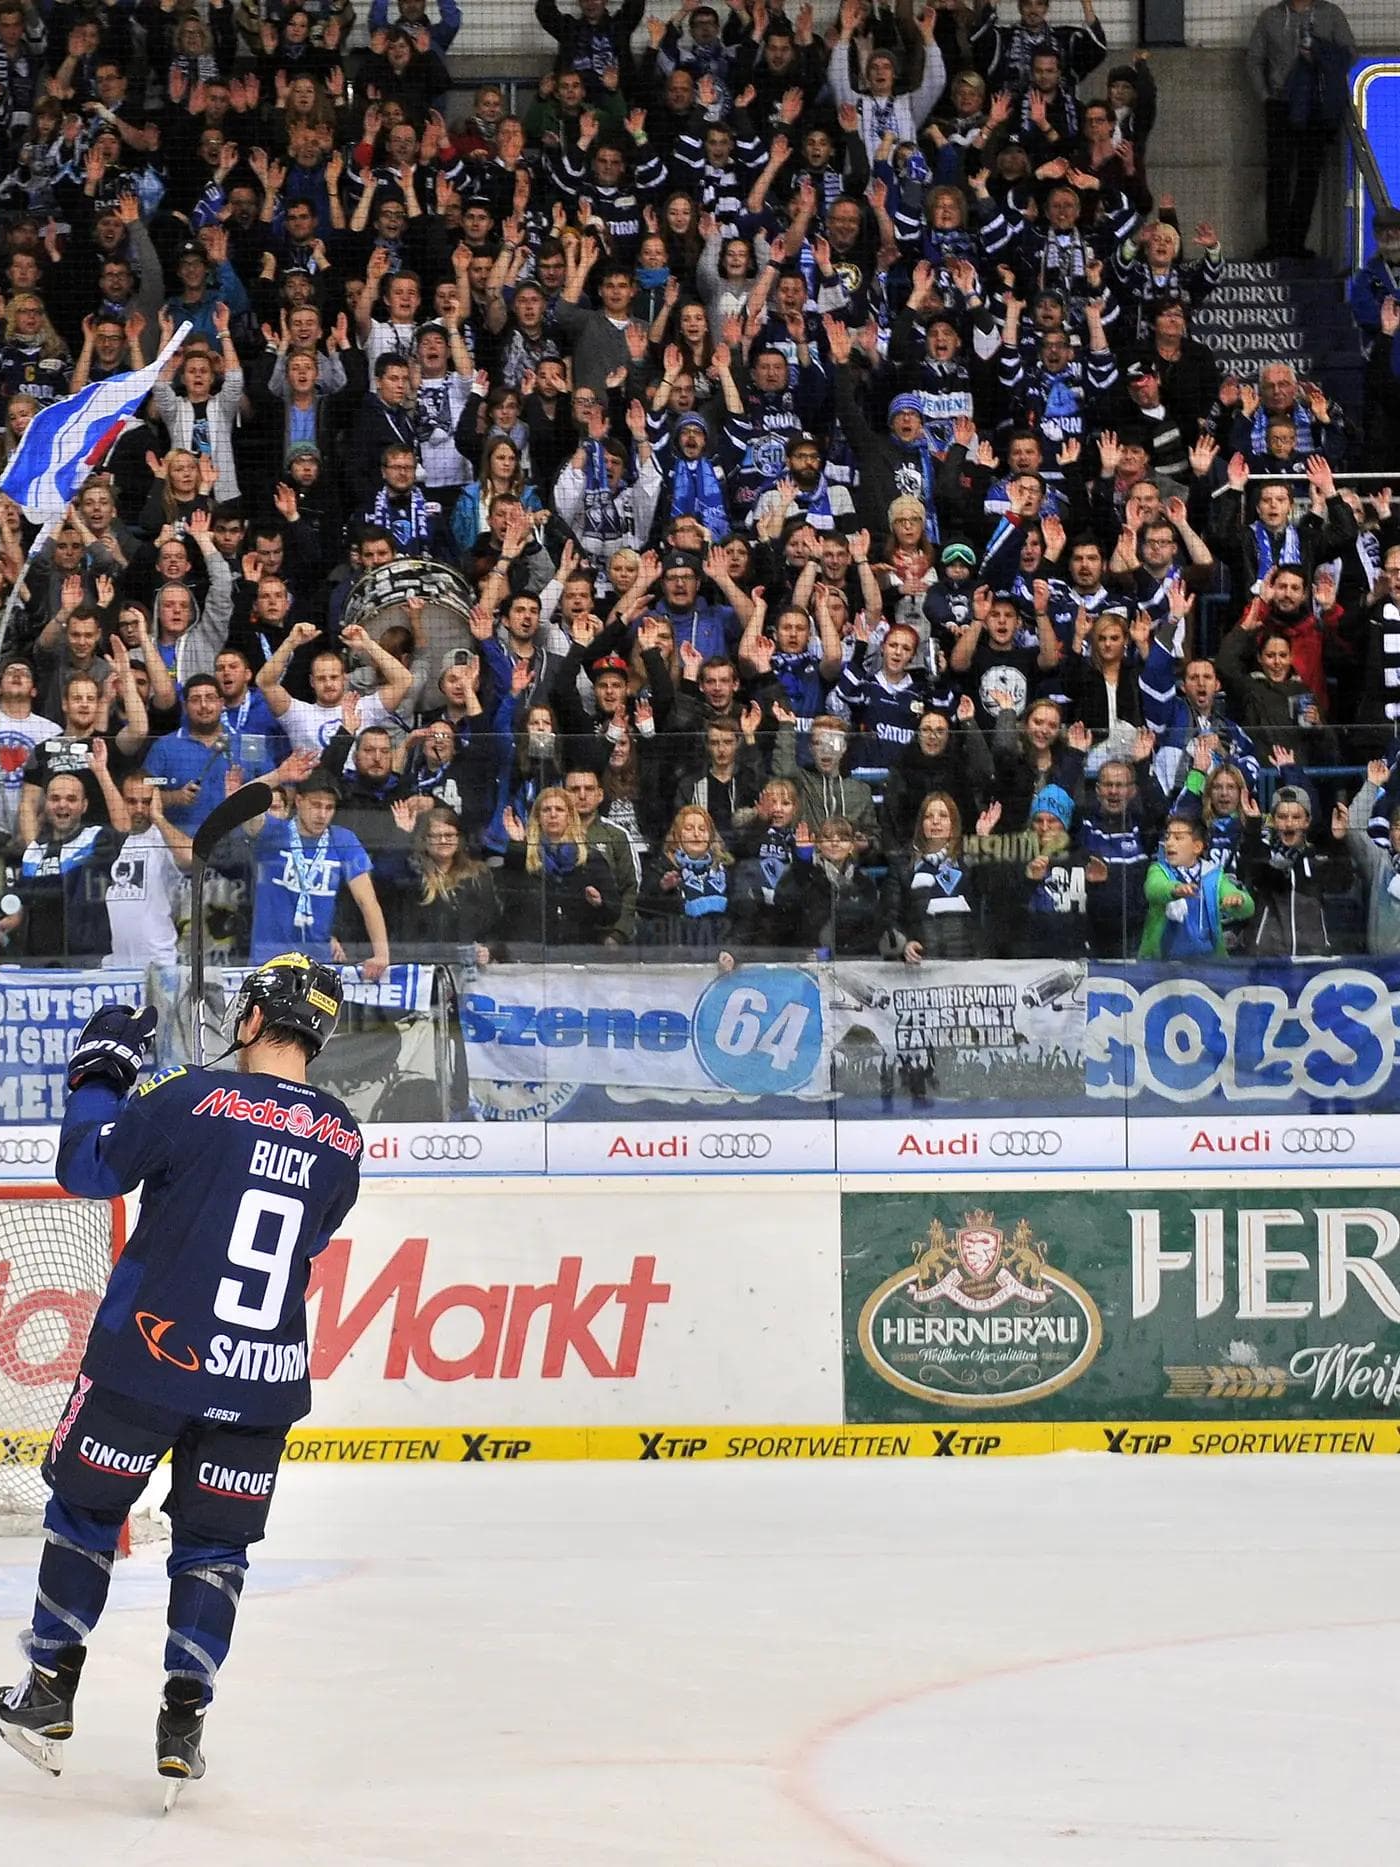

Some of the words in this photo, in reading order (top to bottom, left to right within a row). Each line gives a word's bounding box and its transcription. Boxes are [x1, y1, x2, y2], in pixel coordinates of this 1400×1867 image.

[894, 985, 1016, 1010] SICHERHEITSWAHN
[460, 993, 688, 1052] Szene
[714, 986, 811, 1072] 64
[896, 1004, 1015, 1029] ZERSTÖRT
[896, 1026, 1015, 1050] FANKULTUR
[607, 1136, 688, 1158] Audi
[897, 1133, 979, 1156] Audi
[1189, 1130, 1271, 1153] Audi
[249, 1139, 318, 1190] BUCK
[213, 1188, 305, 1331] 9
[882, 1316, 1078, 1346] HERRNBRÄU
[80, 1436, 156, 1474] CINQUE
[286, 1440, 441, 1462] ORTWETTEN
[725, 1436, 911, 1458] SPORTWETTEN
[1189, 1432, 1375, 1455] SPORTWETTEN
[198, 1462, 274, 1496] CINQUE
